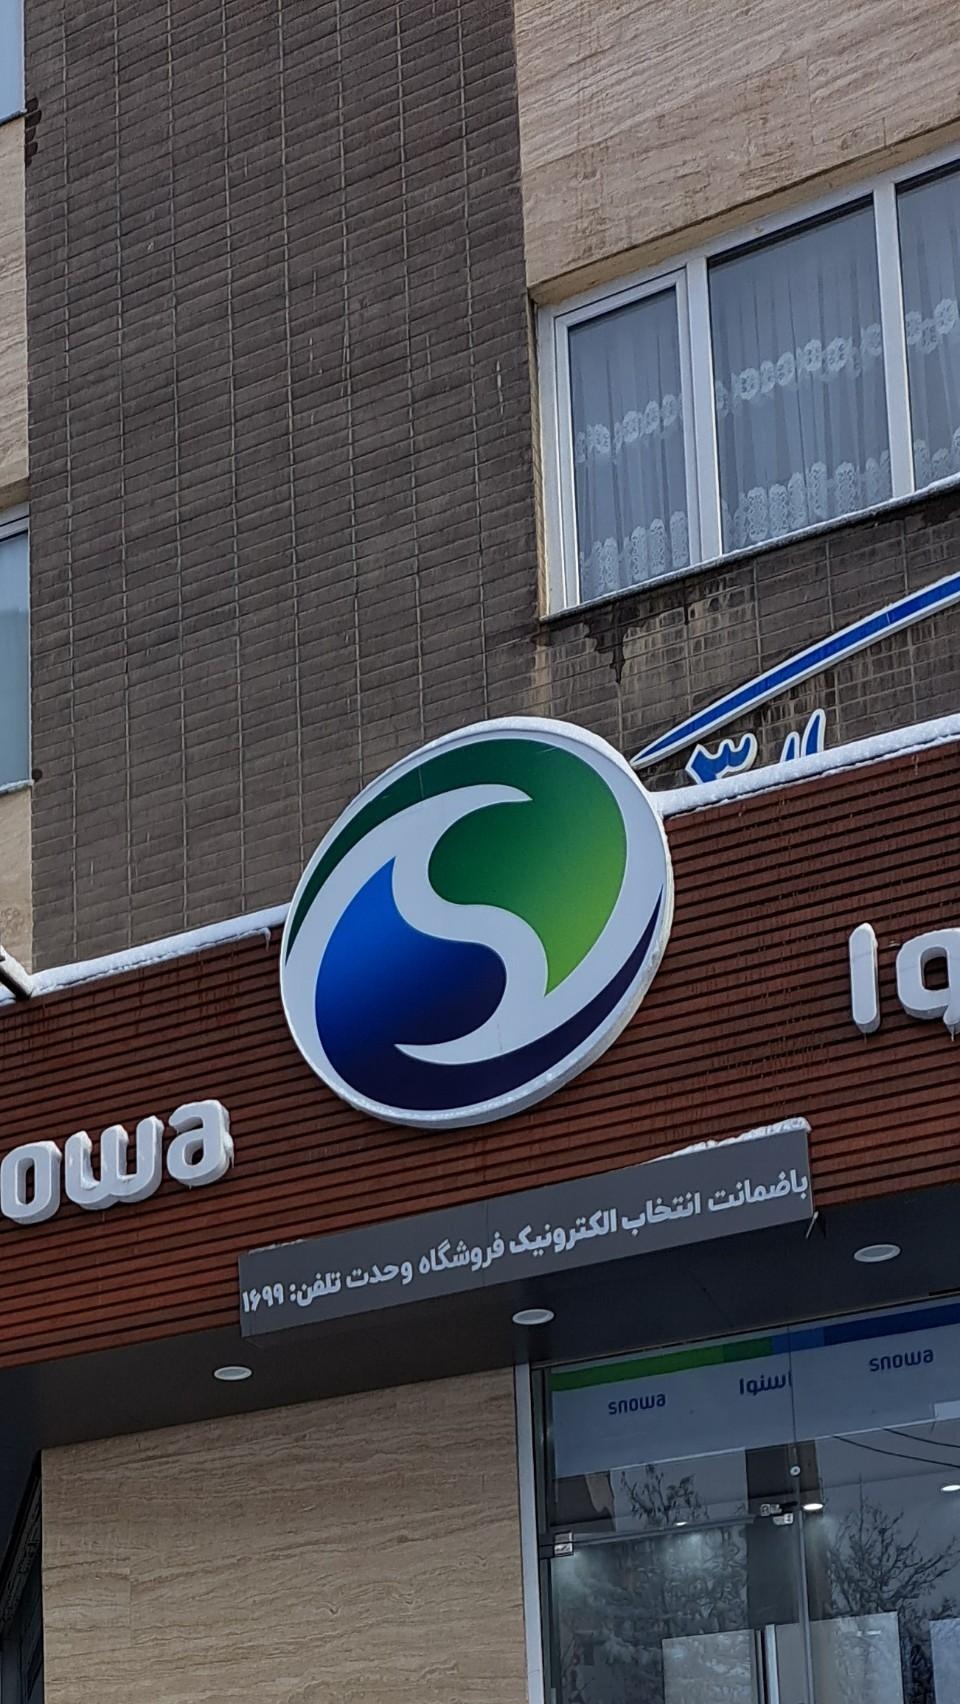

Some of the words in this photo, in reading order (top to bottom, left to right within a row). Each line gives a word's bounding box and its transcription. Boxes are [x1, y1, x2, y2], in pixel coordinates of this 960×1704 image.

[621, 1192, 701, 1237] انتخاب
[509, 1208, 617, 1257] الکترونیک
[419, 1232, 505, 1272] فروشگاه
[346, 1261, 413, 1285] وحدت
[868, 1348, 934, 1372] snowa
[607, 1392, 666, 1416] snowa
